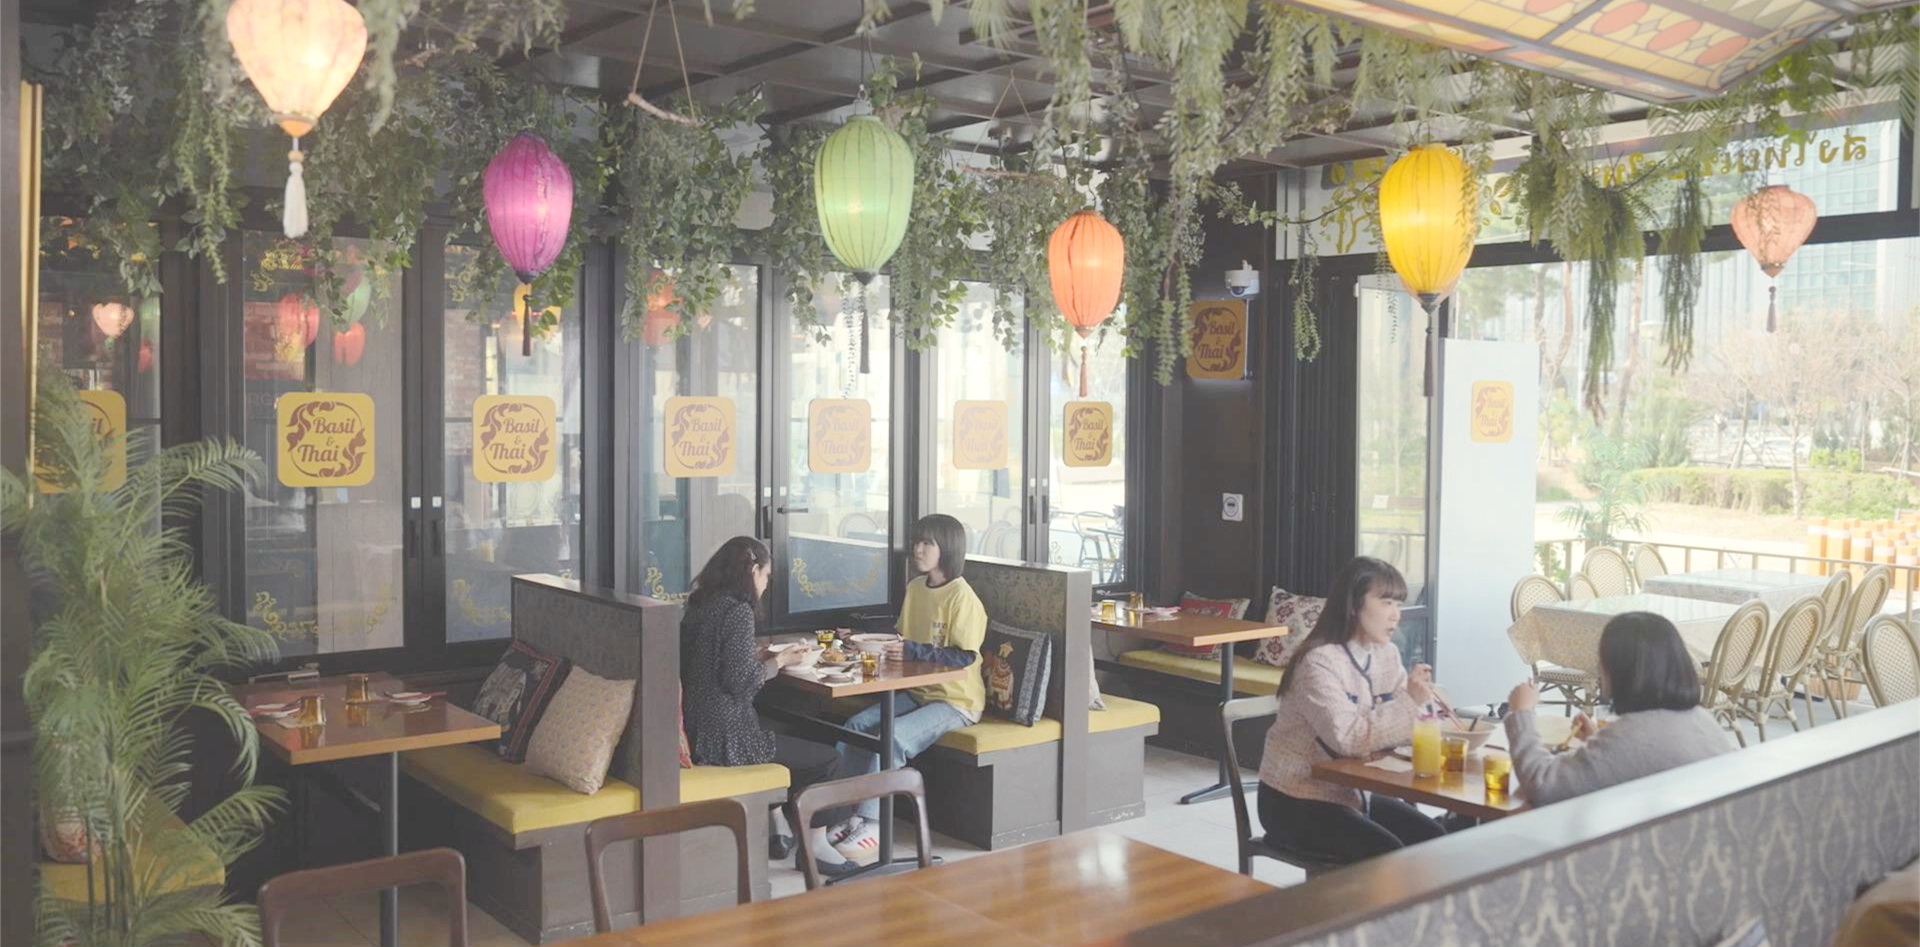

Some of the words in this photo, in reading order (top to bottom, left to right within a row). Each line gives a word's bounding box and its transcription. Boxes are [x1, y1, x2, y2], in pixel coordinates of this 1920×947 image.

[1198, 343, 1225, 358] Thai
[313, 416, 355, 433] Basil
[503, 417, 540, 433] Basil
[691, 417, 722, 432] Basil
[679, 441, 710, 456] Thai
[1074, 437, 1095, 450] Thai
[298, 444, 339, 462] Thai
[490, 443, 526, 460] Thai
